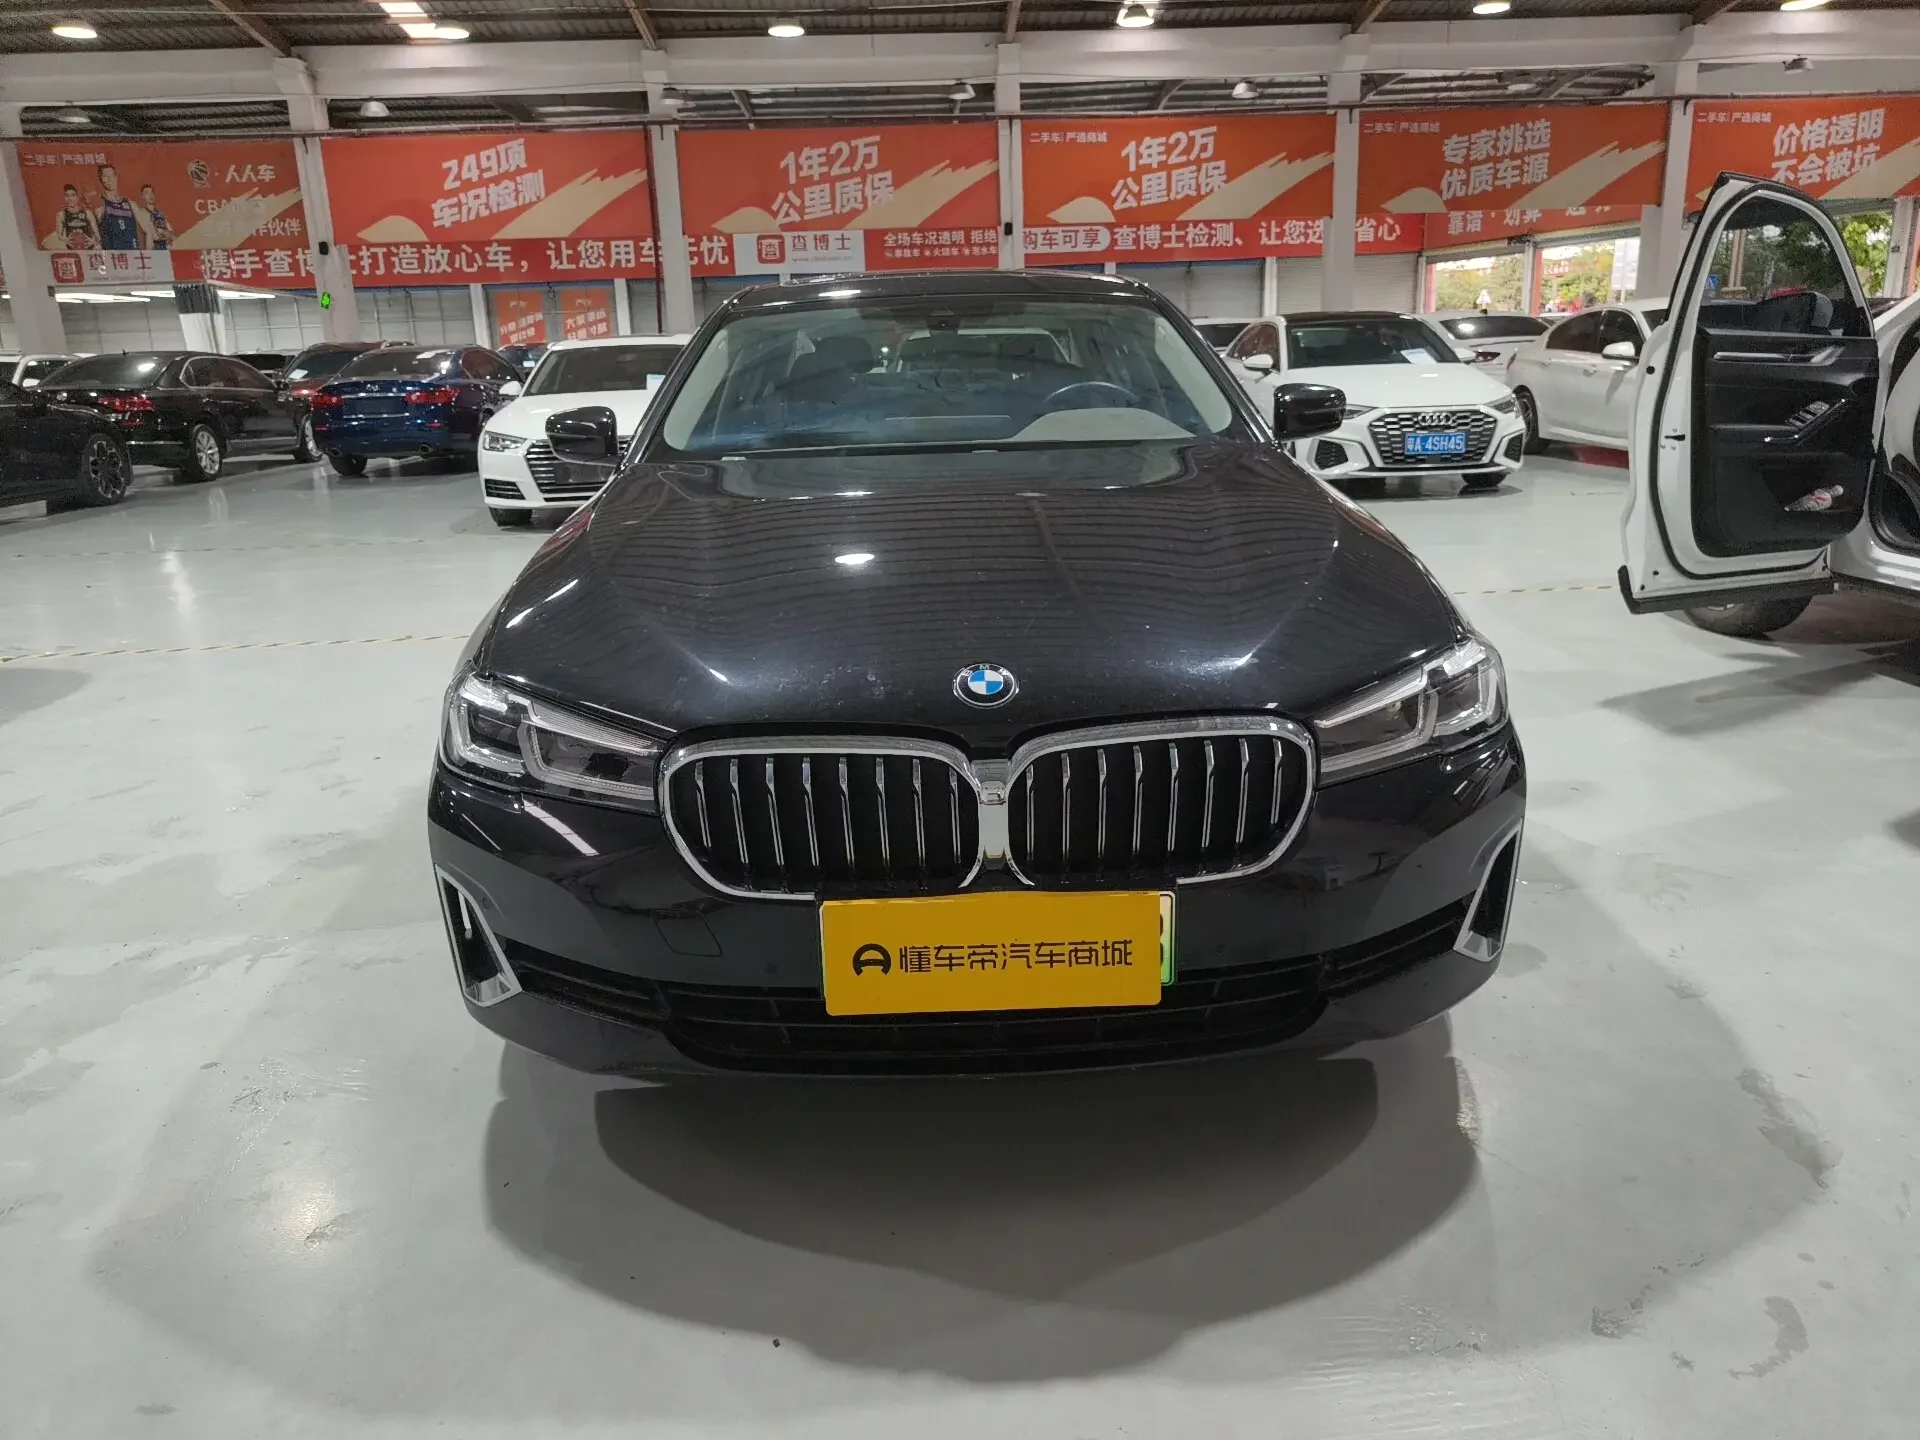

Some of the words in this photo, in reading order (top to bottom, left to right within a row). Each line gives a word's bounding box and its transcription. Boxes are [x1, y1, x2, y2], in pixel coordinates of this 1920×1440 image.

[1121, 126, 1217, 172] 1年2万
[1442, 118, 1551, 164] 专家挑选
[1773, 108, 1885, 157] 价格透明
[225, 164, 275, 182] 人人车
[442, 138, 528, 190] 249项
[780, 135, 880, 184] 1年2万
[1440, 152, 1550, 200] 优质车源
[1770, 143, 1880, 186] 不会被坑
[432, 169, 545, 228] 车况检测
[771, 170, 894, 225] 公里质保
[1111, 160, 1227, 211] 公里质保
[792, 234, 851, 252] 查博士
[884, 231, 965, 246] 全场车况透明
[970, 230, 997, 244] 拒绝
[1023, 229, 1101, 250] 购车可享
[900, 939, 1133, 973] 懂车帝汽车商城
